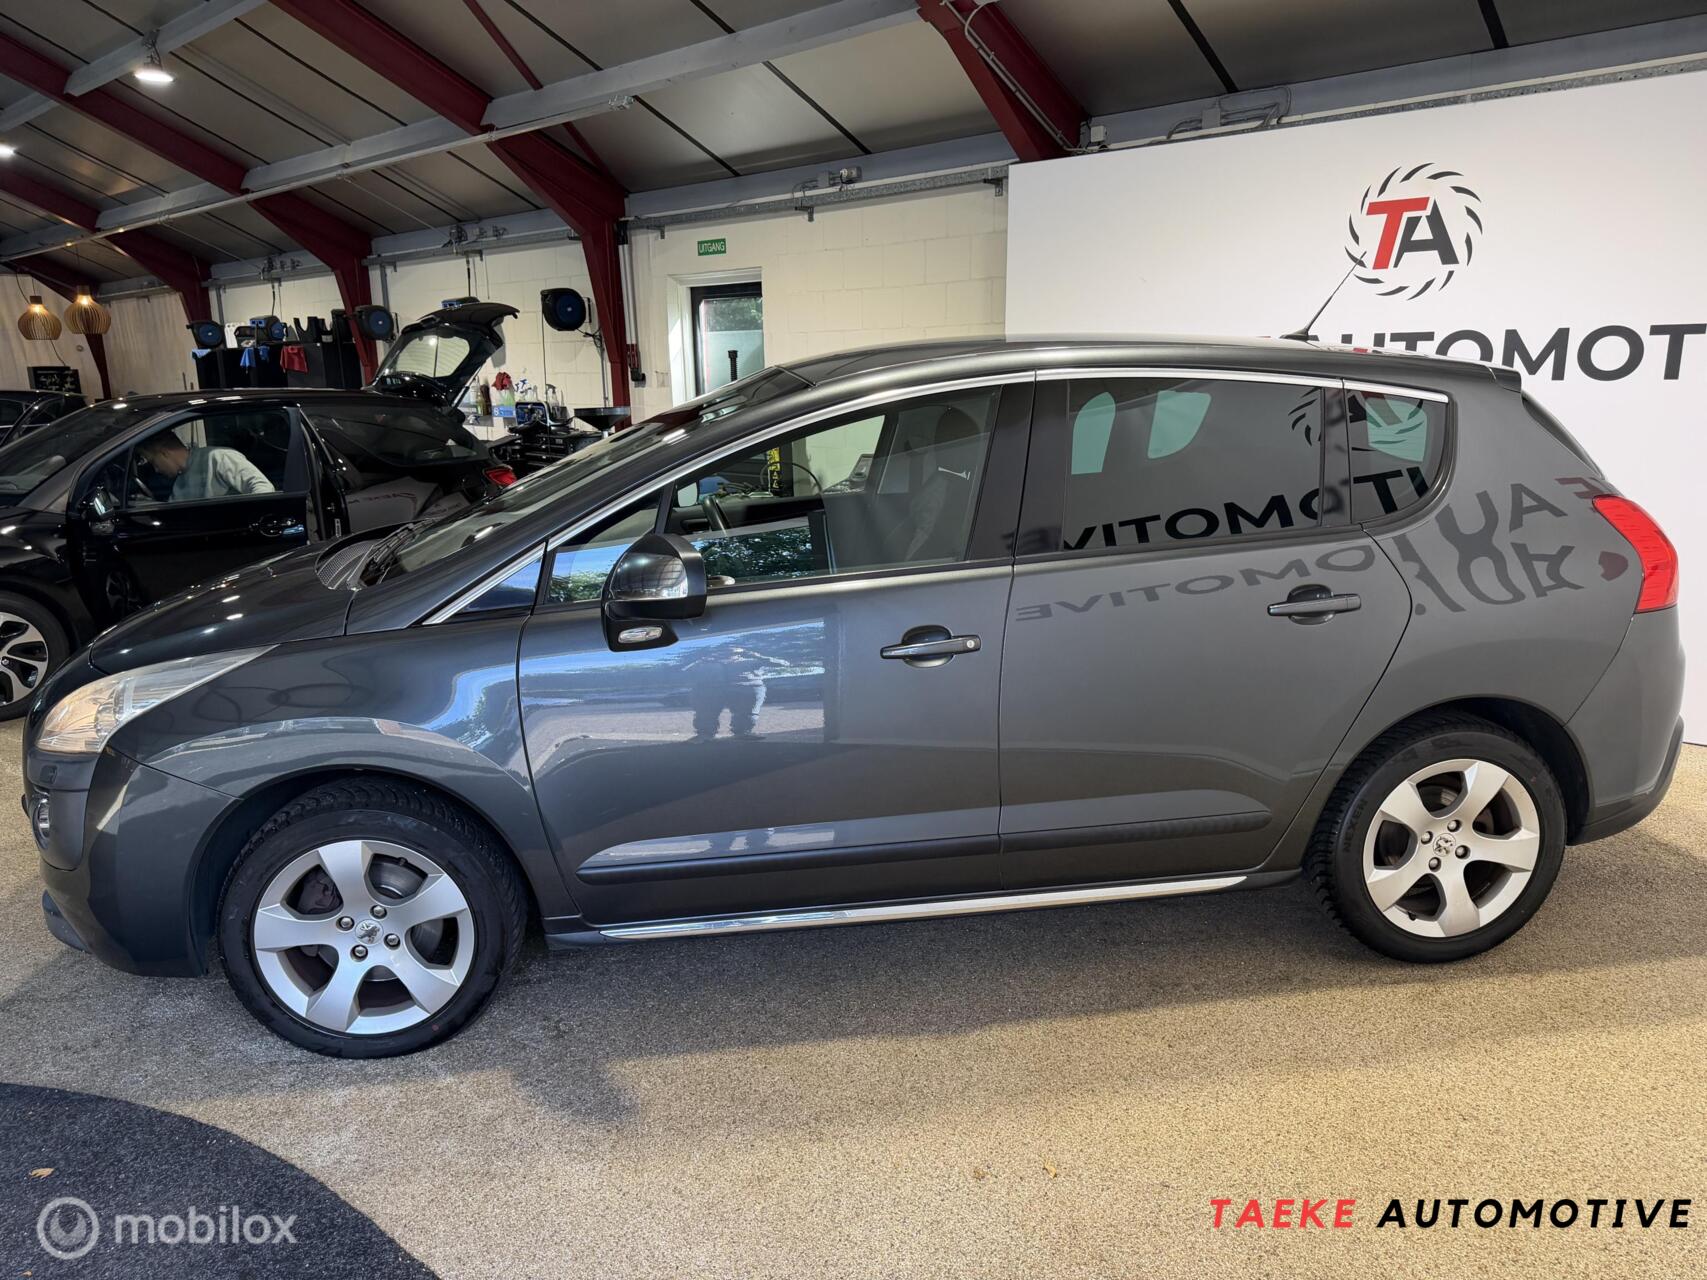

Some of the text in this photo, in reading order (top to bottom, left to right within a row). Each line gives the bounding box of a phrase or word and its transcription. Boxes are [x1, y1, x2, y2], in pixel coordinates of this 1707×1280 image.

[698, 241, 726, 254] UITGANG
[1366, 196, 1460, 270] TA
[1307, 323, 1707, 381] TOMOT
